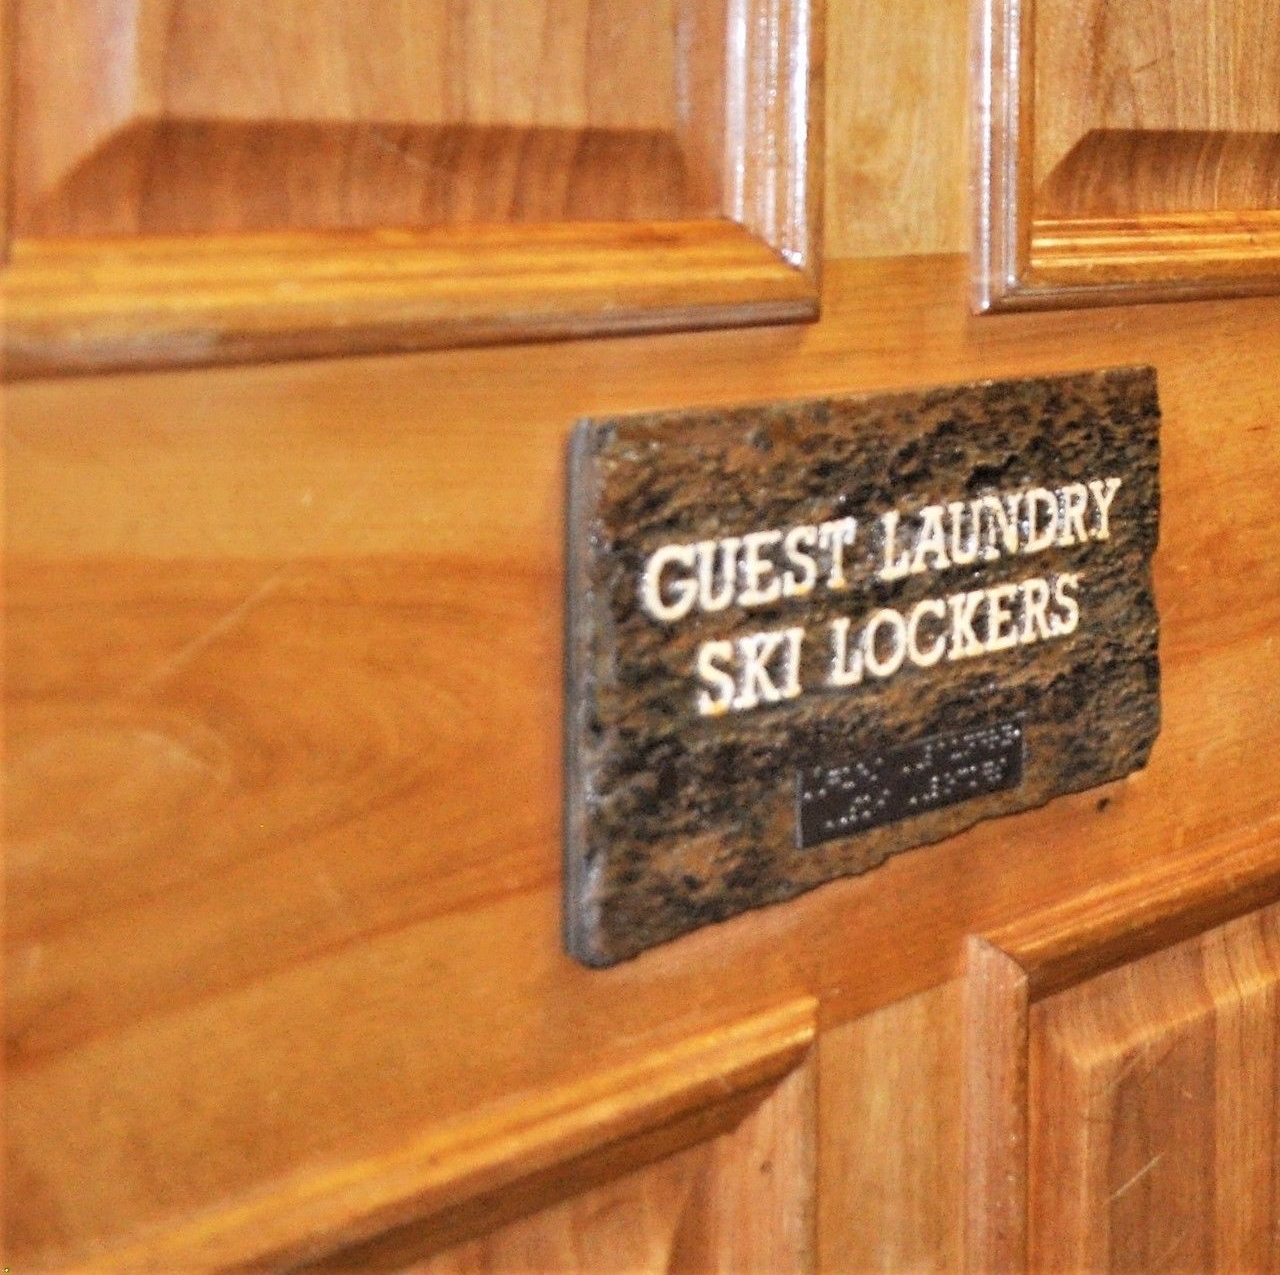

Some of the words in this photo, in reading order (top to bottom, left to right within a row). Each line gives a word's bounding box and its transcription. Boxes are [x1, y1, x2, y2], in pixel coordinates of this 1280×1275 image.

[640, 517, 857, 624] GUEST
[878, 477, 1123, 581] LAUNDRY
[698, 627, 807, 719] SKI
[828, 573, 1085, 687] LOCKERS
